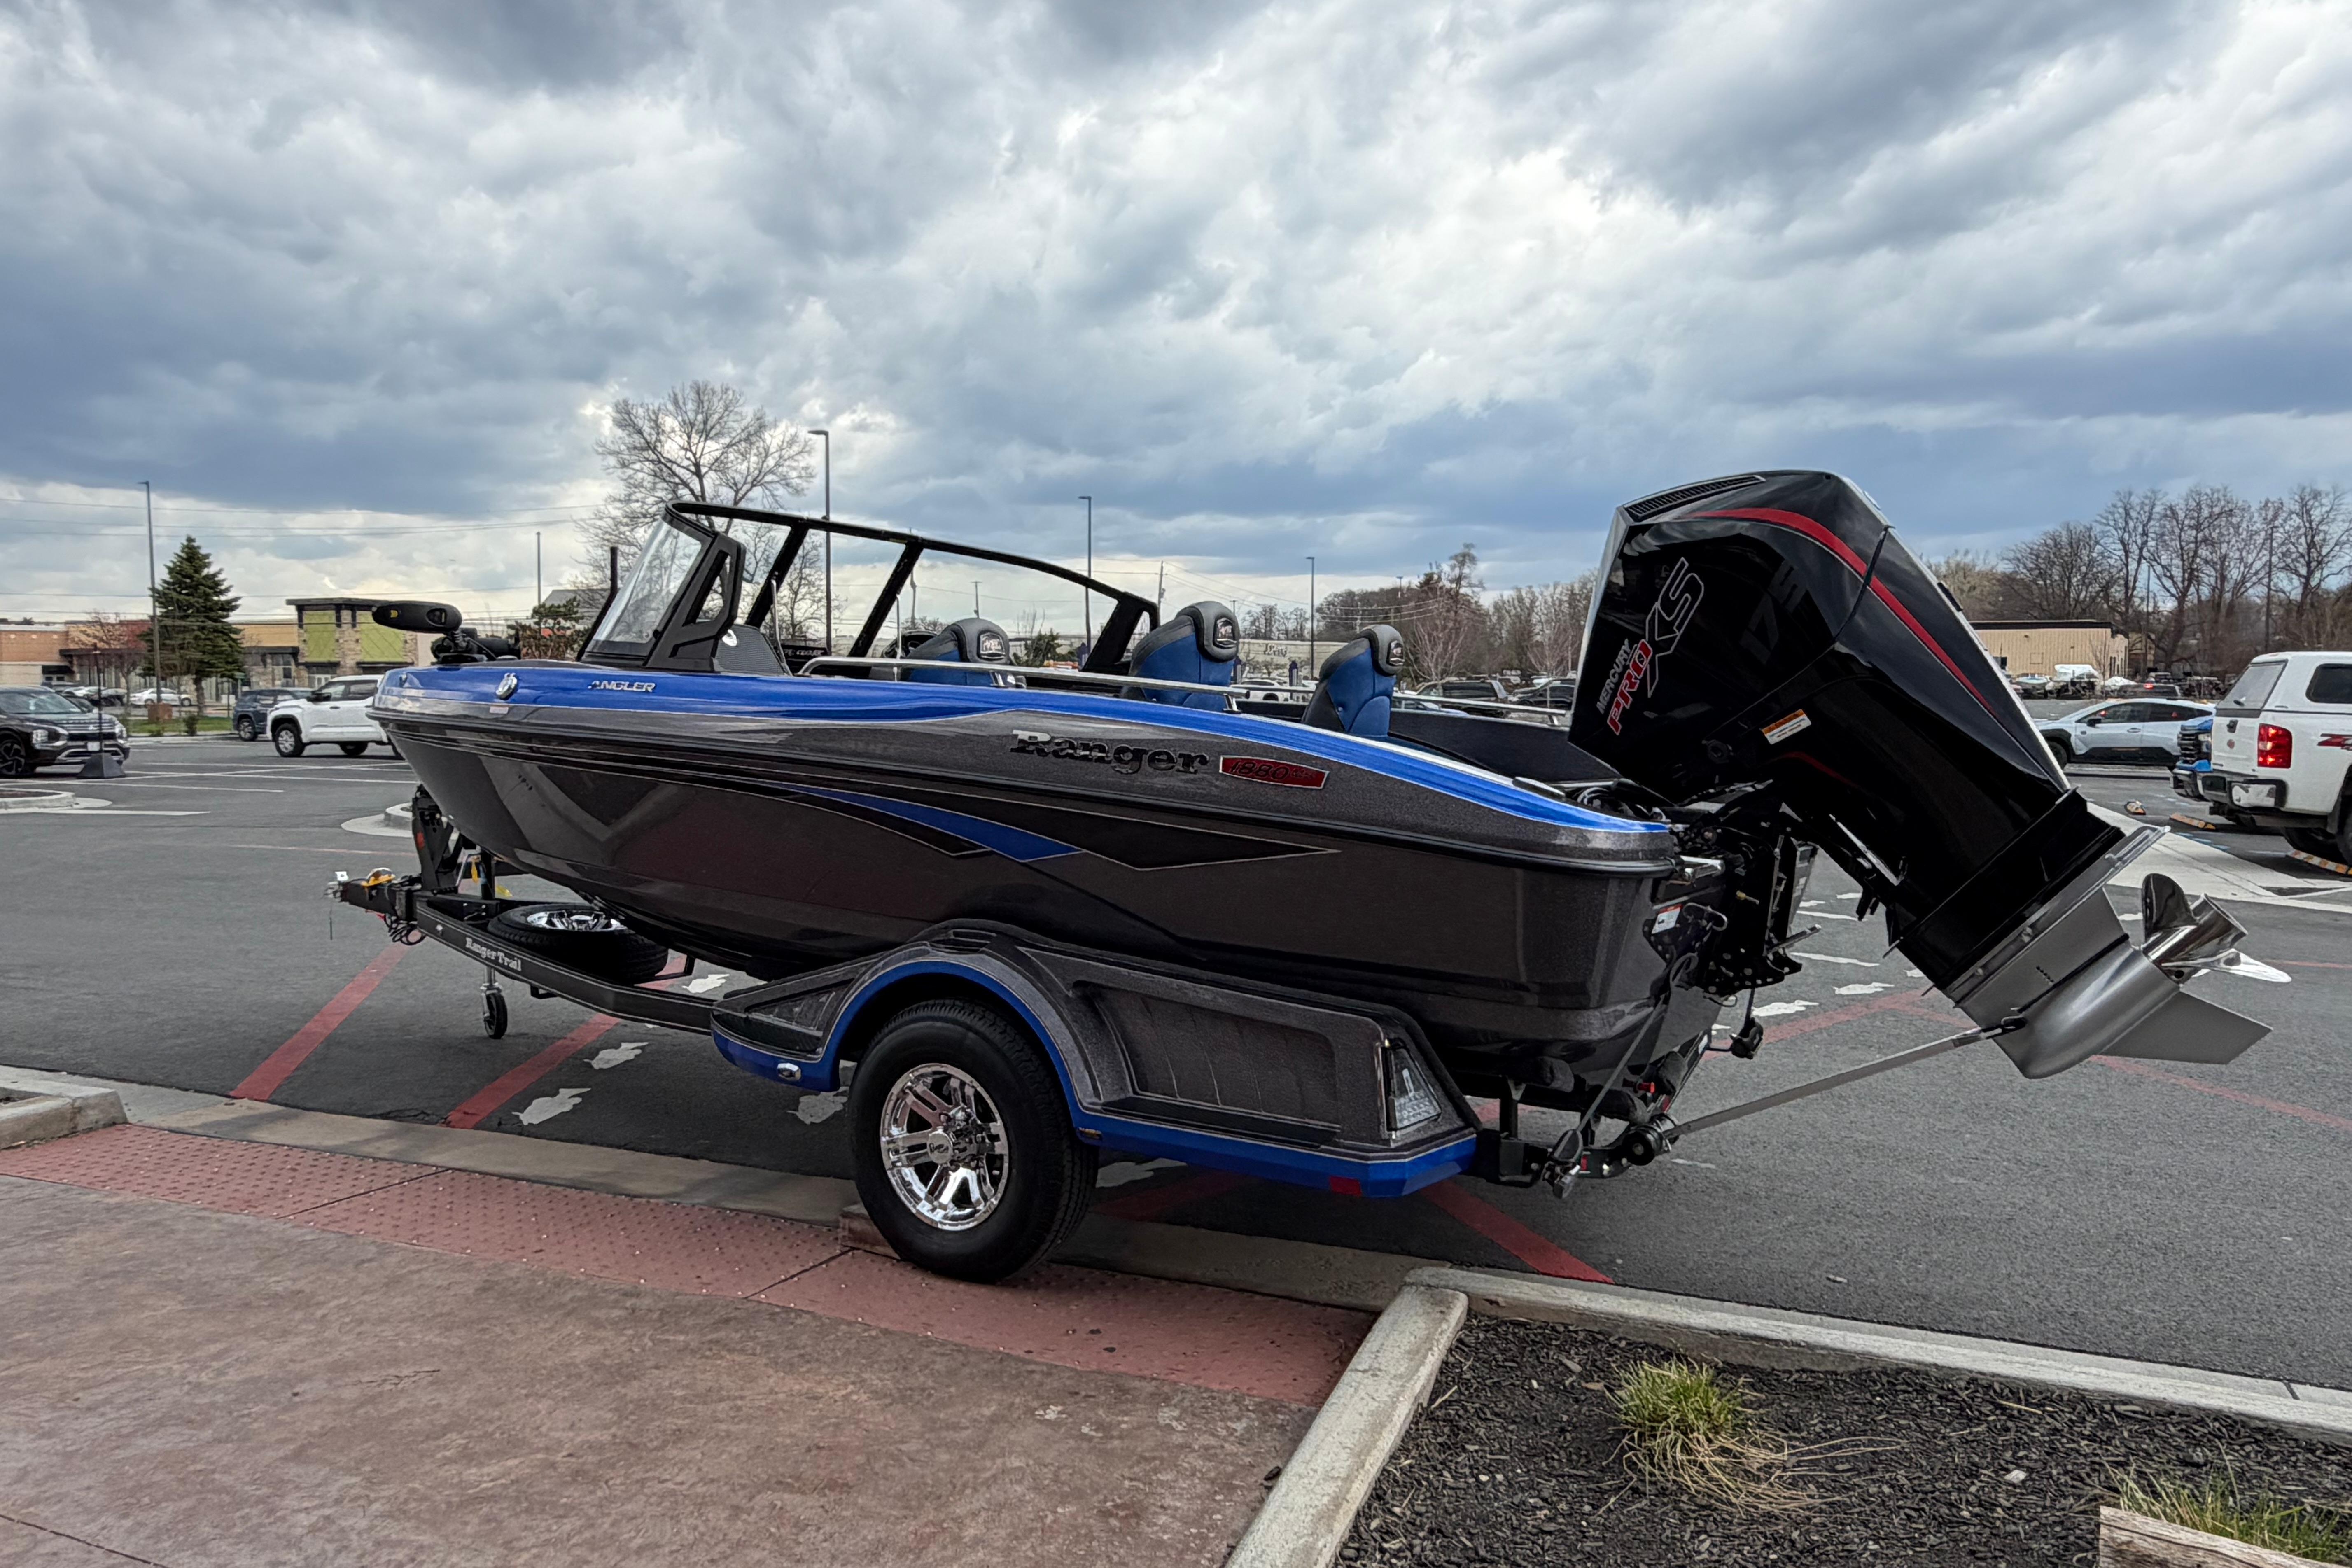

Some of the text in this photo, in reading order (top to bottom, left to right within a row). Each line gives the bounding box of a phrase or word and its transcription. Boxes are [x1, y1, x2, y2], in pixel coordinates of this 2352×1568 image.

[1607, 557, 1705, 735] PRO XS
[587, 680, 656, 692] ANGLER
[1596, 638, 1631, 714] MERCURY
[1010, 730, 1209, 775] Ranger
[1229, 760, 1290, 780] 1880
